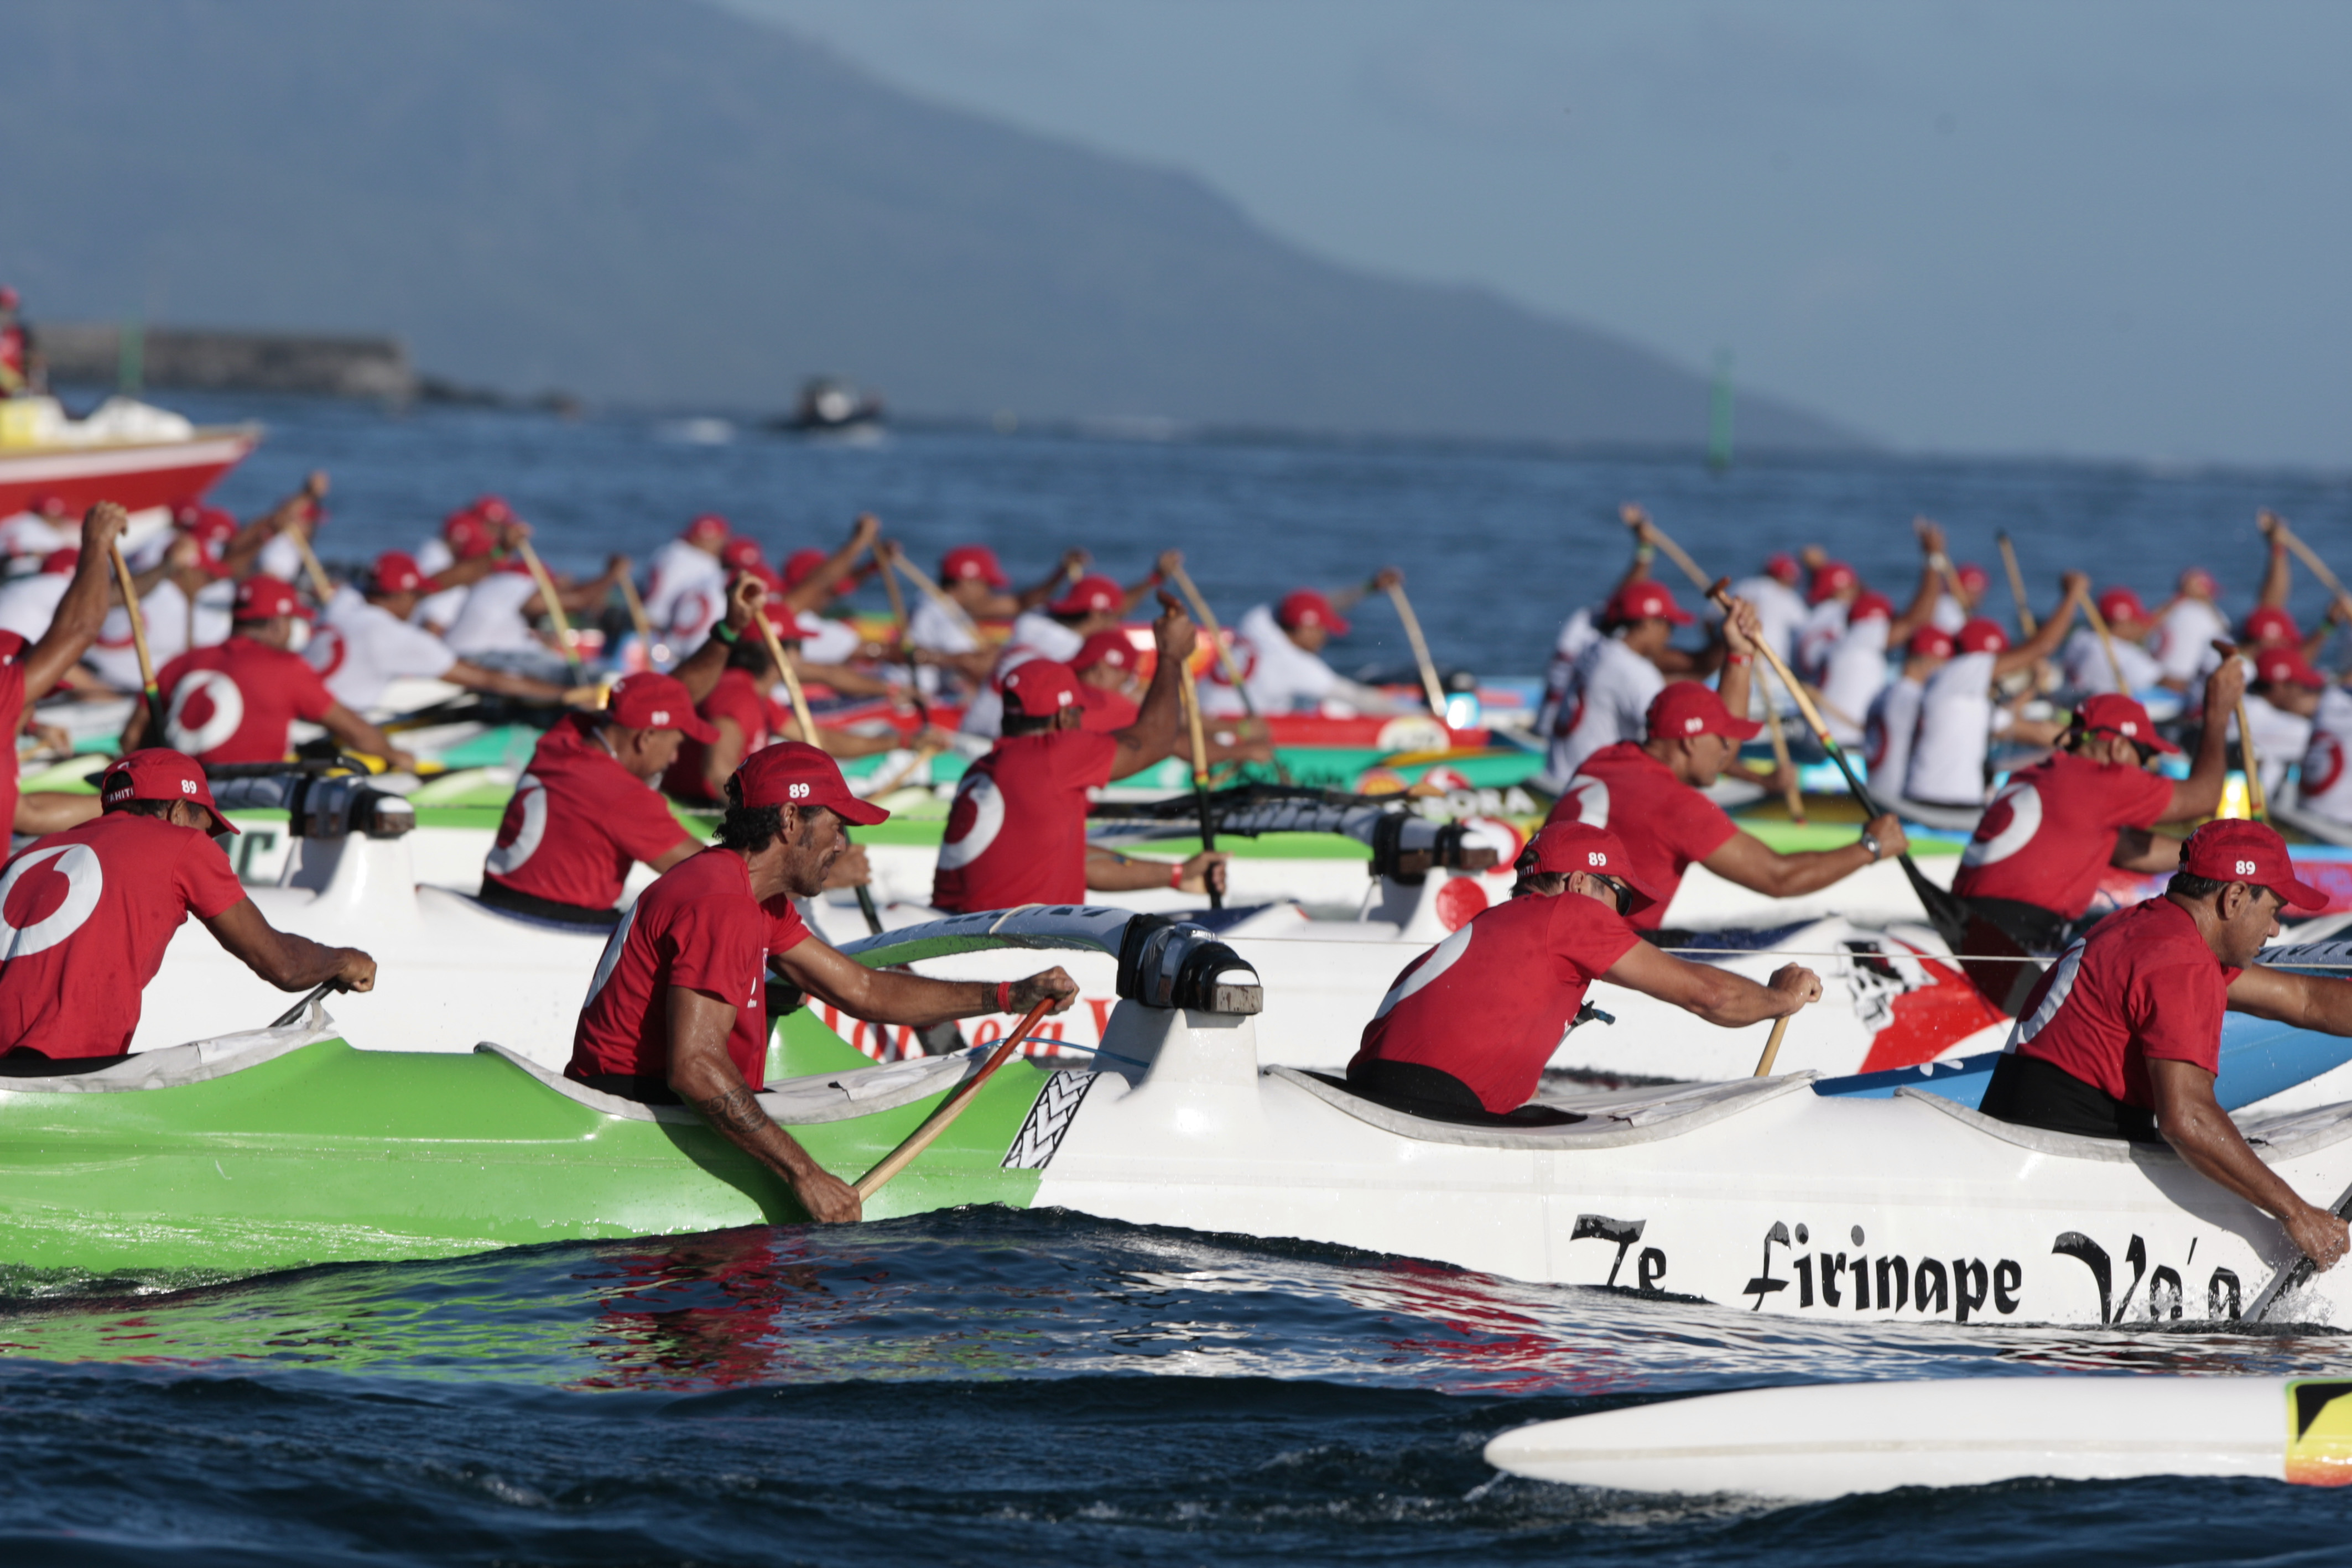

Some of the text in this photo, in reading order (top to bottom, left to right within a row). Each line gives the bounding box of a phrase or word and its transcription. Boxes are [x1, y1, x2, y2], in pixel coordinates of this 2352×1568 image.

[181, 779, 197, 794] 89
[789, 783, 810, 798] 89
[107, 787, 134, 803] TAHITI
[1589, 852, 1607, 867] 89
[2236, 860, 2256, 875] 89
